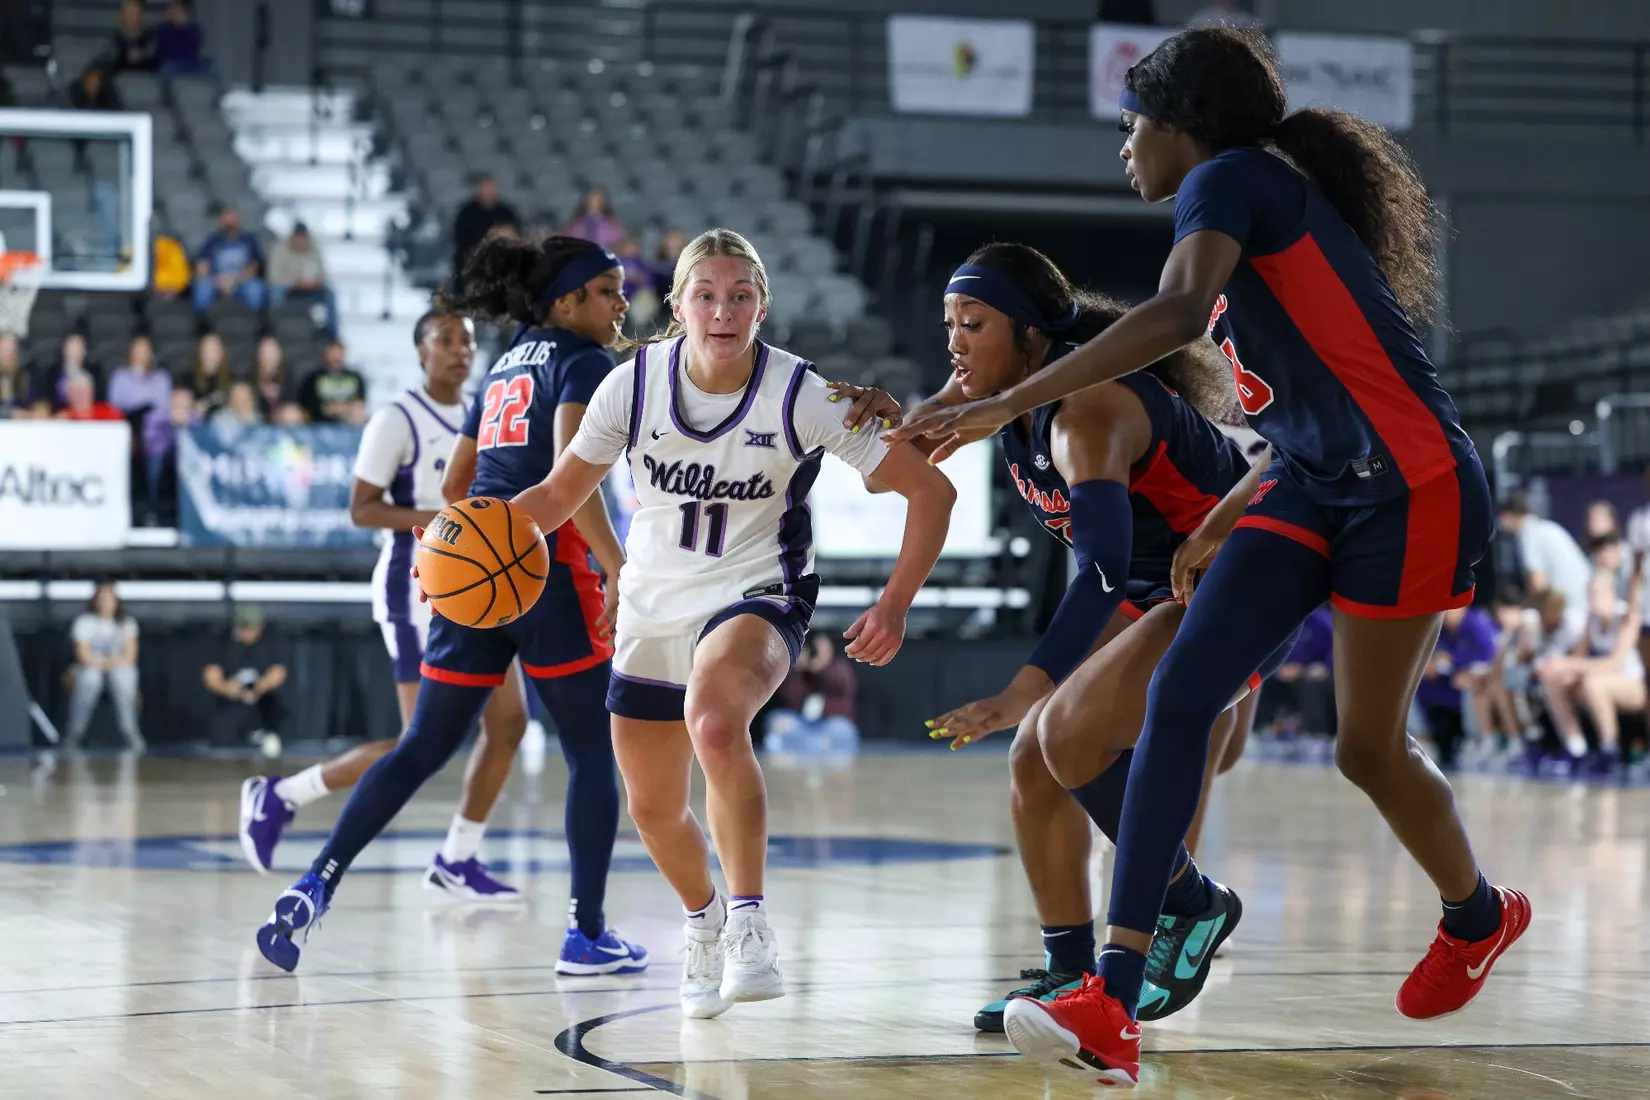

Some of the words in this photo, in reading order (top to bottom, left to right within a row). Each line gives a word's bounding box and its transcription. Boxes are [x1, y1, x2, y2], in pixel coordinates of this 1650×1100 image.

[477, 373, 534, 452] 22
[643, 454, 776, 501] Wildcats
[679, 501, 729, 558] 11
